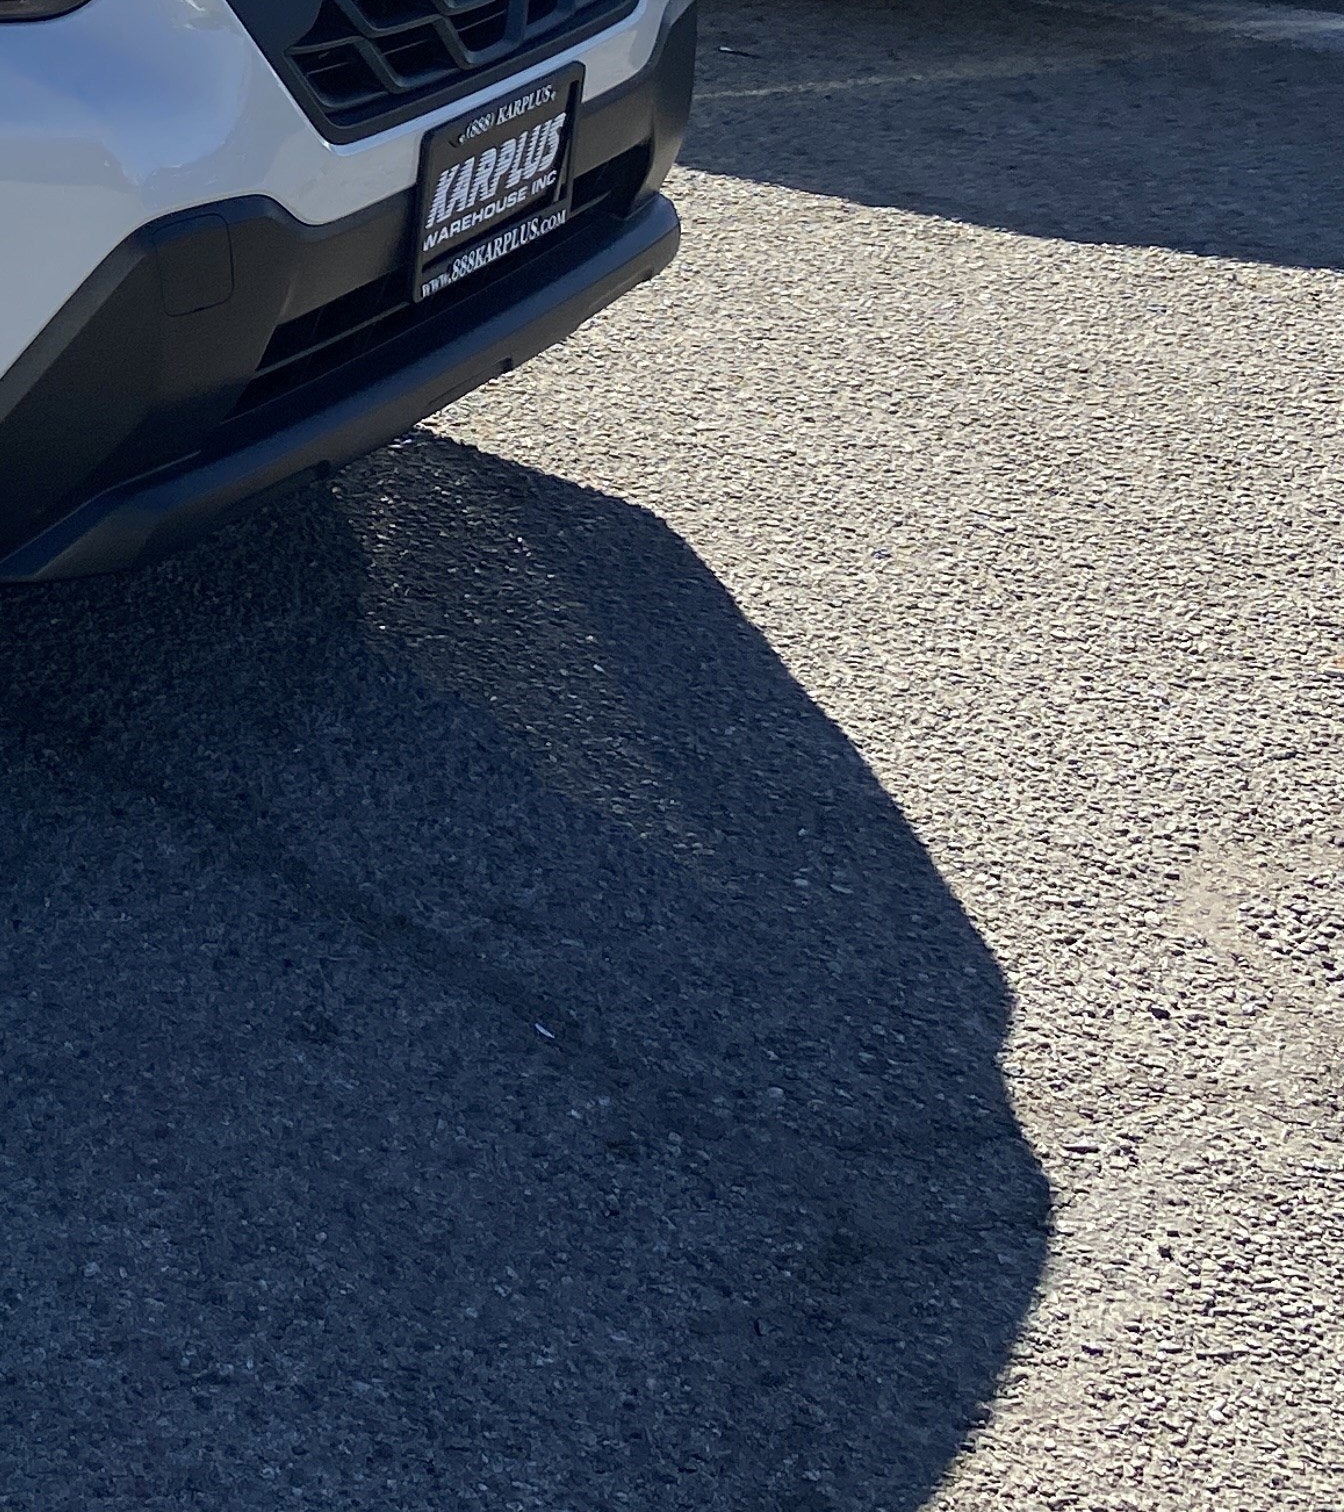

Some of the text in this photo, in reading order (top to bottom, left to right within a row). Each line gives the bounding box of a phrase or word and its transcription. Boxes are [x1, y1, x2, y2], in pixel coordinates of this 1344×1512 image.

[496, 84, 553, 126] KARPLUS
[422, 169, 558, 253] WAREHOUSE INC
[424, 112, 567, 230] KARPLUS
